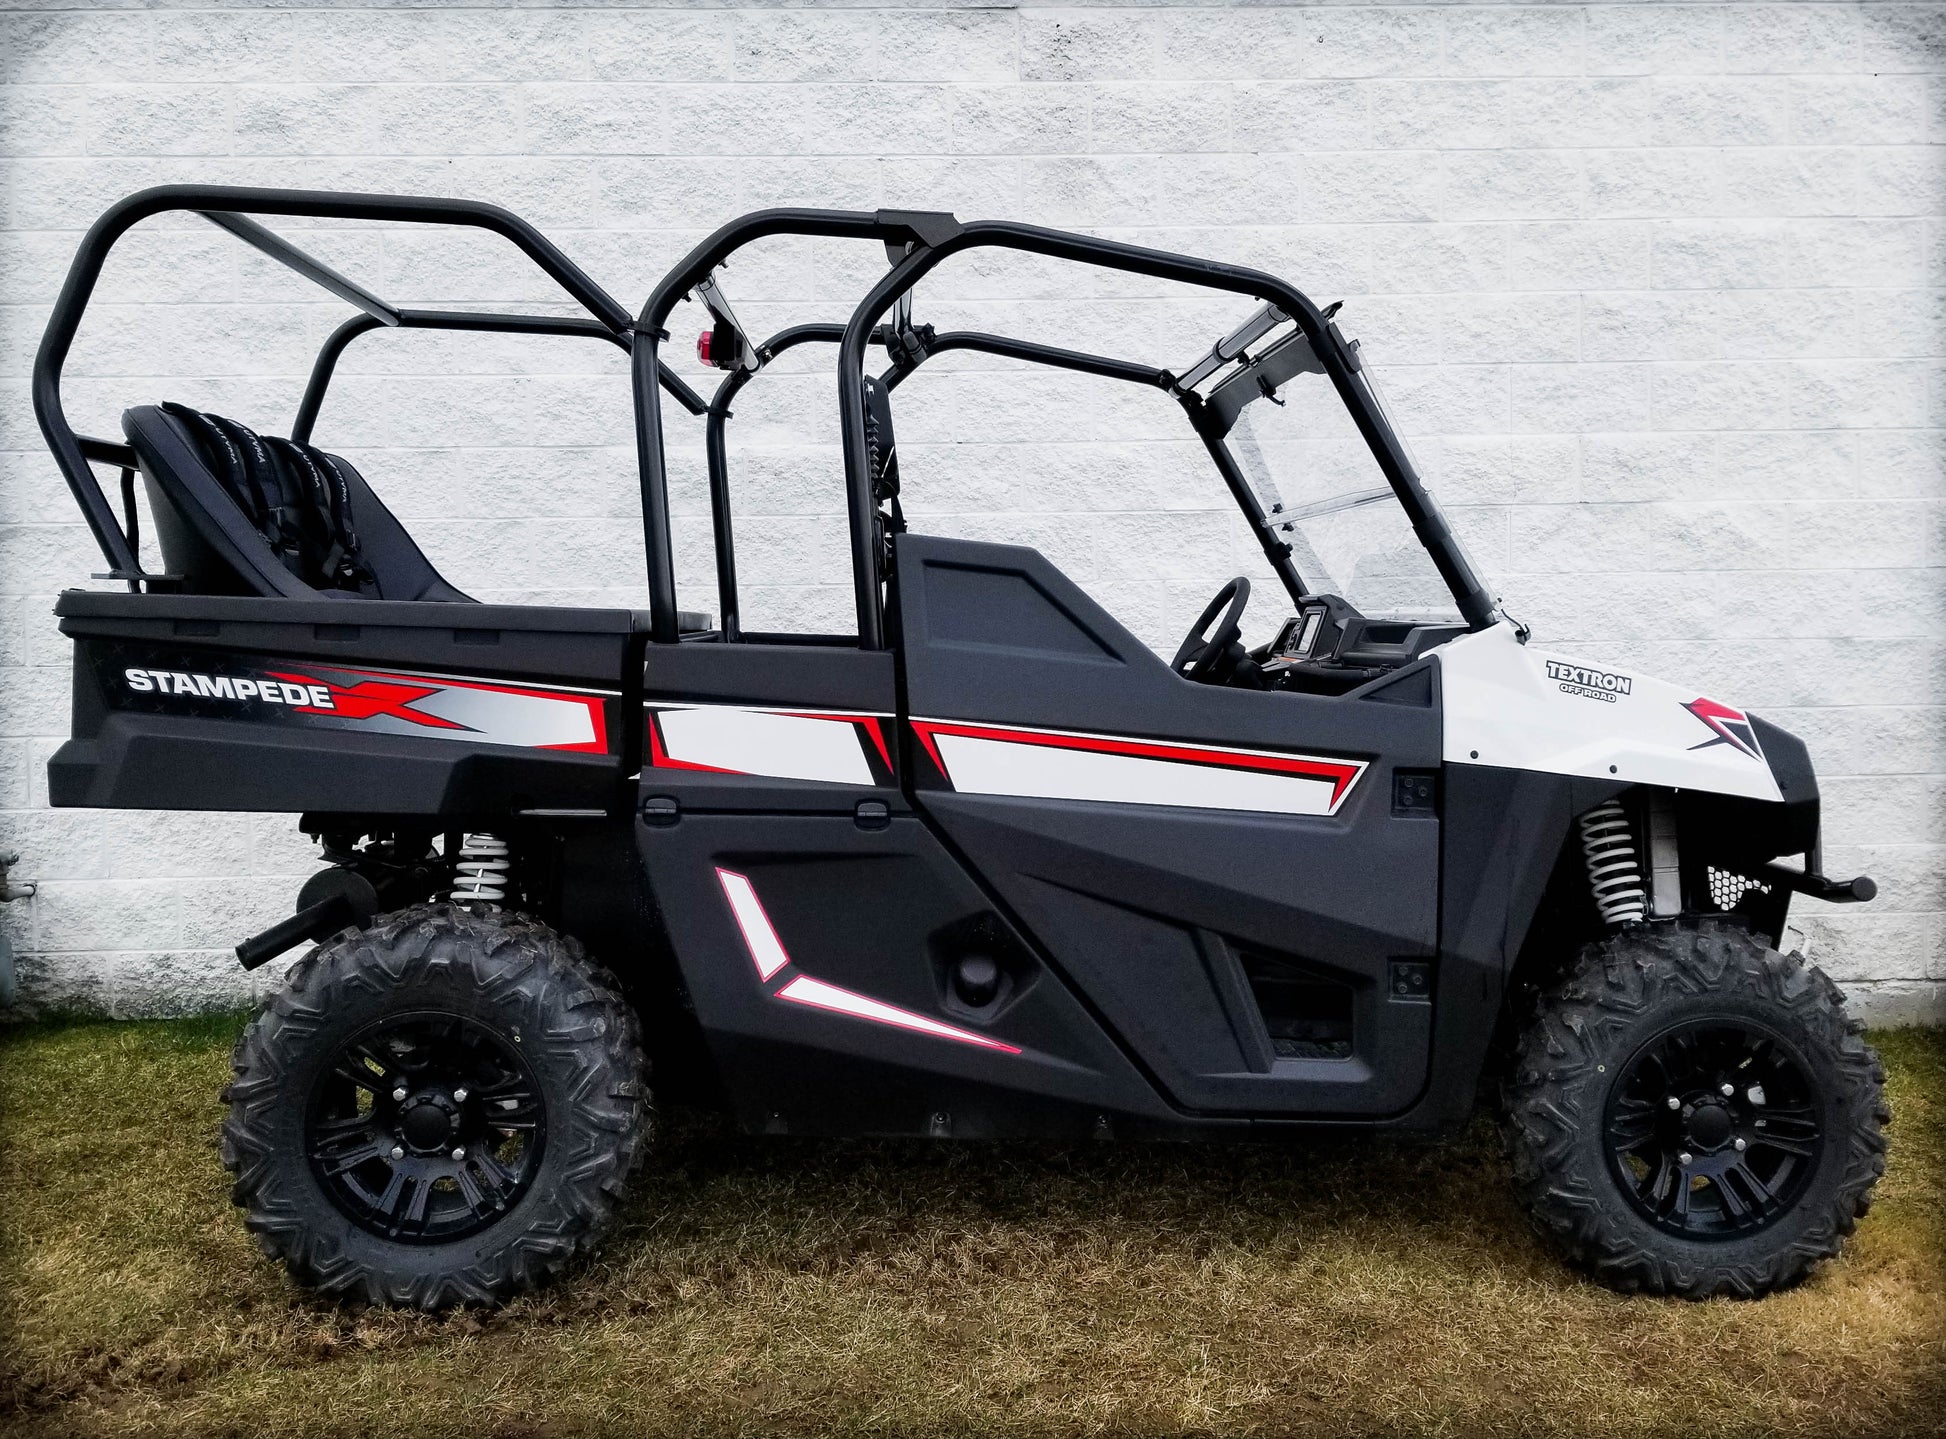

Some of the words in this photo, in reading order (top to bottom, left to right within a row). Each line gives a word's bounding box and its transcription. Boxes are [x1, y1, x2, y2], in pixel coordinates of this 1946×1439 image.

[125, 668, 335, 709] STAMPEDE
[1546, 660, 1632, 695] TEXTRON
[1559, 683, 1582, 695] OFF
[1582, 688, 1617, 703] ROAD
